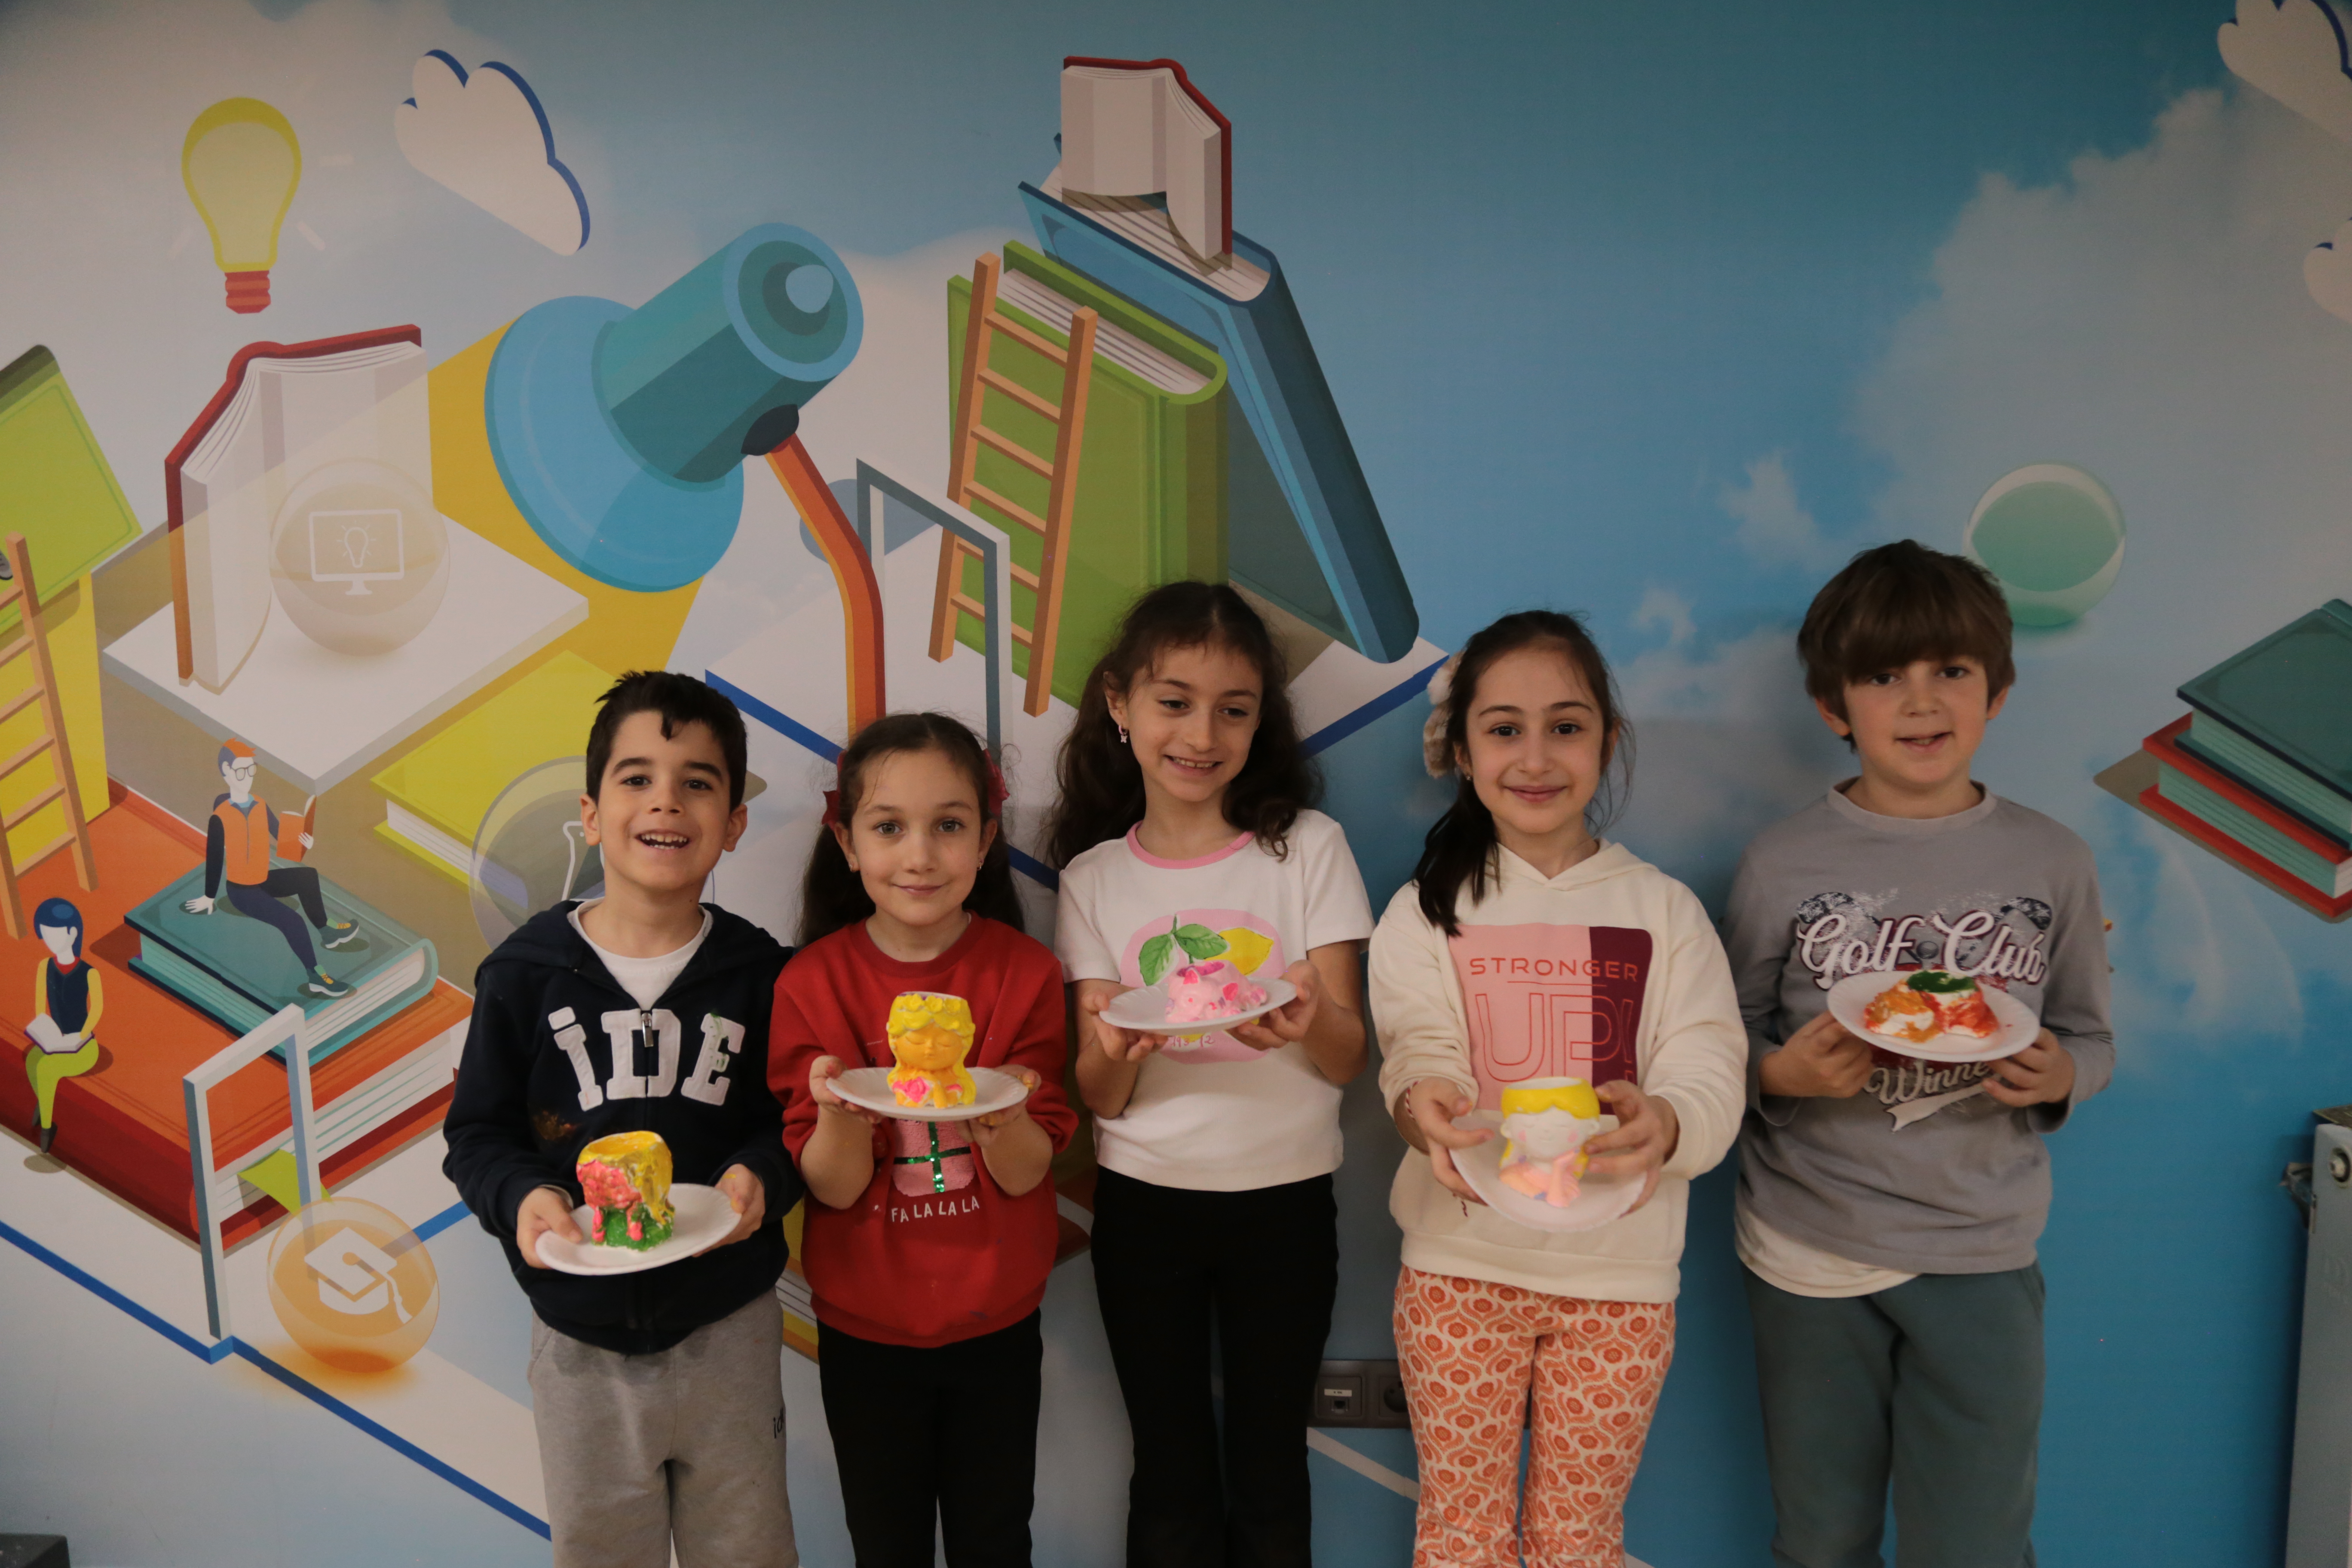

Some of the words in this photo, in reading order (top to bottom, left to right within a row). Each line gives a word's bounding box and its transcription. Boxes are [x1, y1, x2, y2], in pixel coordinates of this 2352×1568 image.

[1797, 912, 1926, 989] Golf
[1934, 910, 2045, 983] Club
[1470, 957, 1638, 982] STRONGER
[891, 1208, 909, 1222] FA
[913, 1203, 933, 1218] LA
[938, 1201, 957, 1216] LA
[962, 1196, 980, 1213] LA
